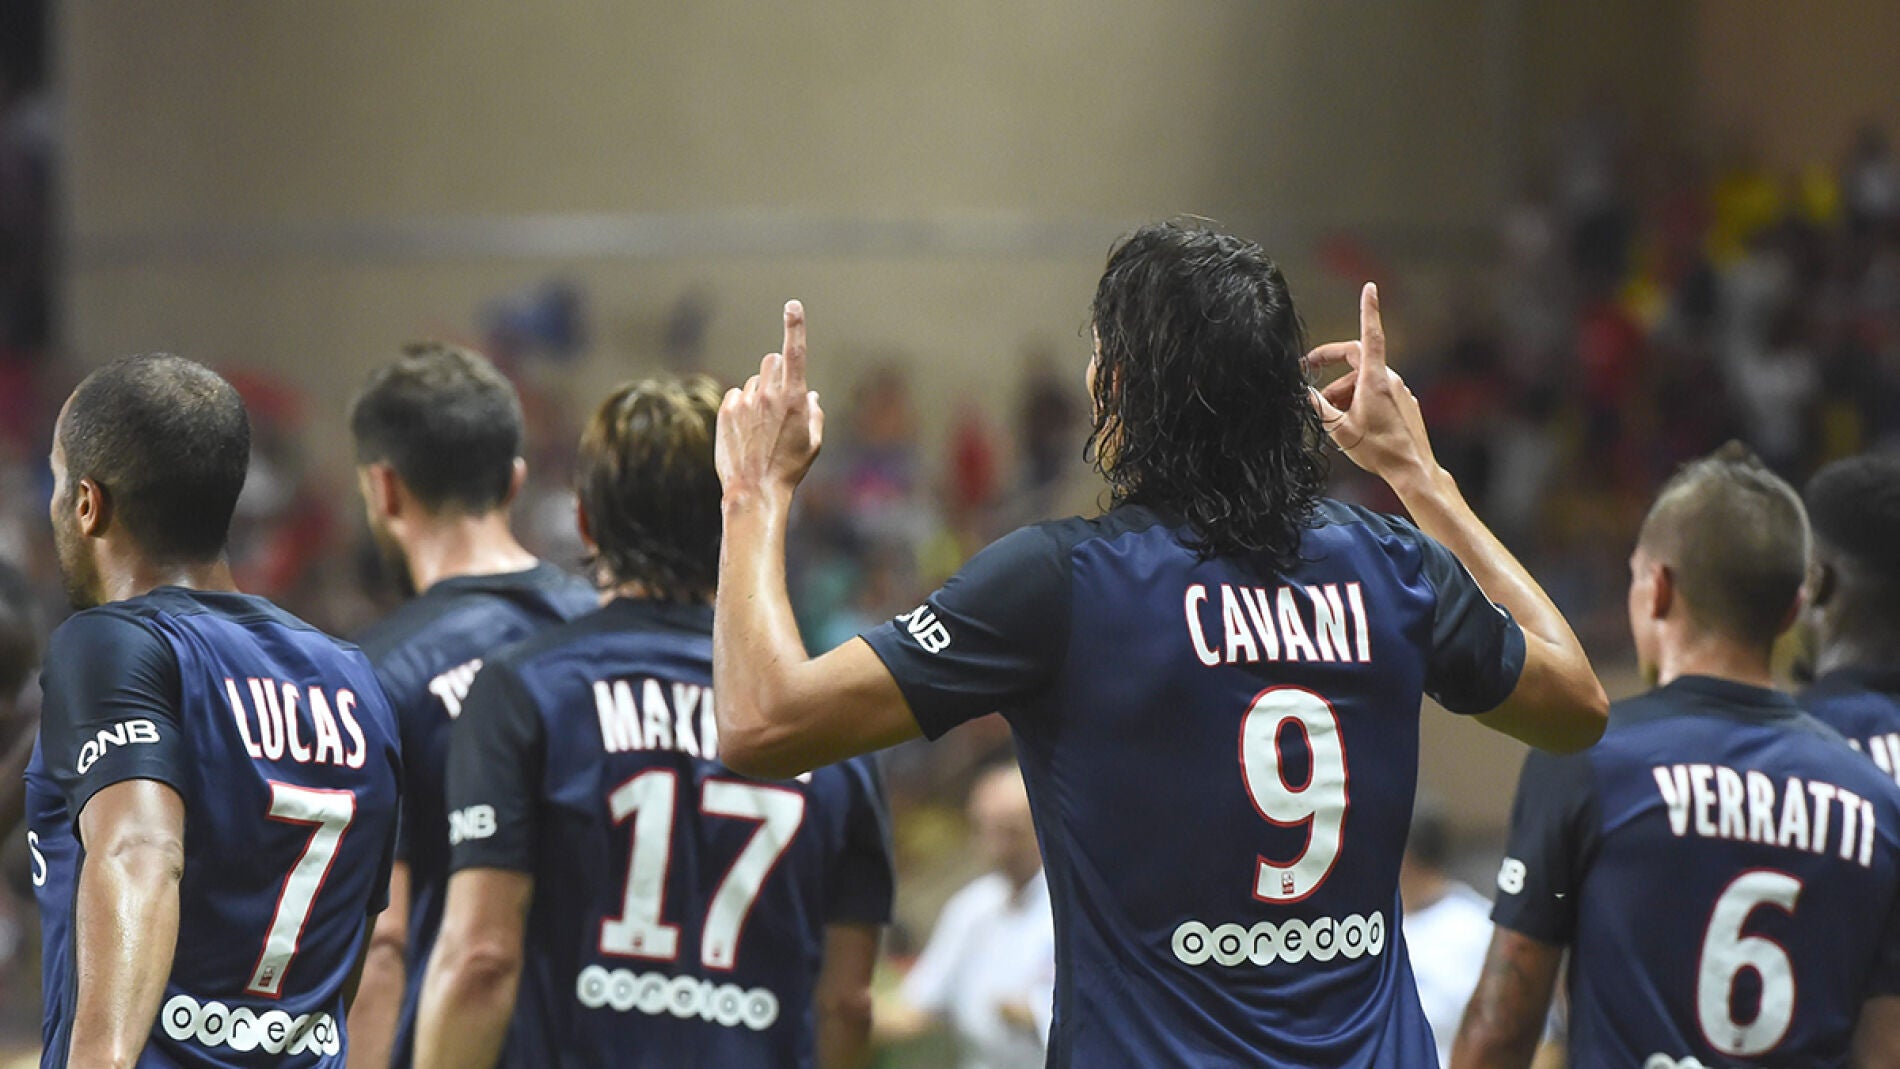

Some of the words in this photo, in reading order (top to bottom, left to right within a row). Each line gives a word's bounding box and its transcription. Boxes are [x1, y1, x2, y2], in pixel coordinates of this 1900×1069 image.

[1184, 581, 1371, 665] CAVANI
[77, 719, 160, 774] QNB
[224, 678, 367, 768] LUCAS
[1238, 684, 1350, 903] 9
[1652, 763, 1876, 868] VERRATTI
[245, 779, 357, 999] 7
[599, 768, 805, 970] 17
[1171, 910, 1385, 967] ooredoo
[1697, 865, 1803, 1058] 6
